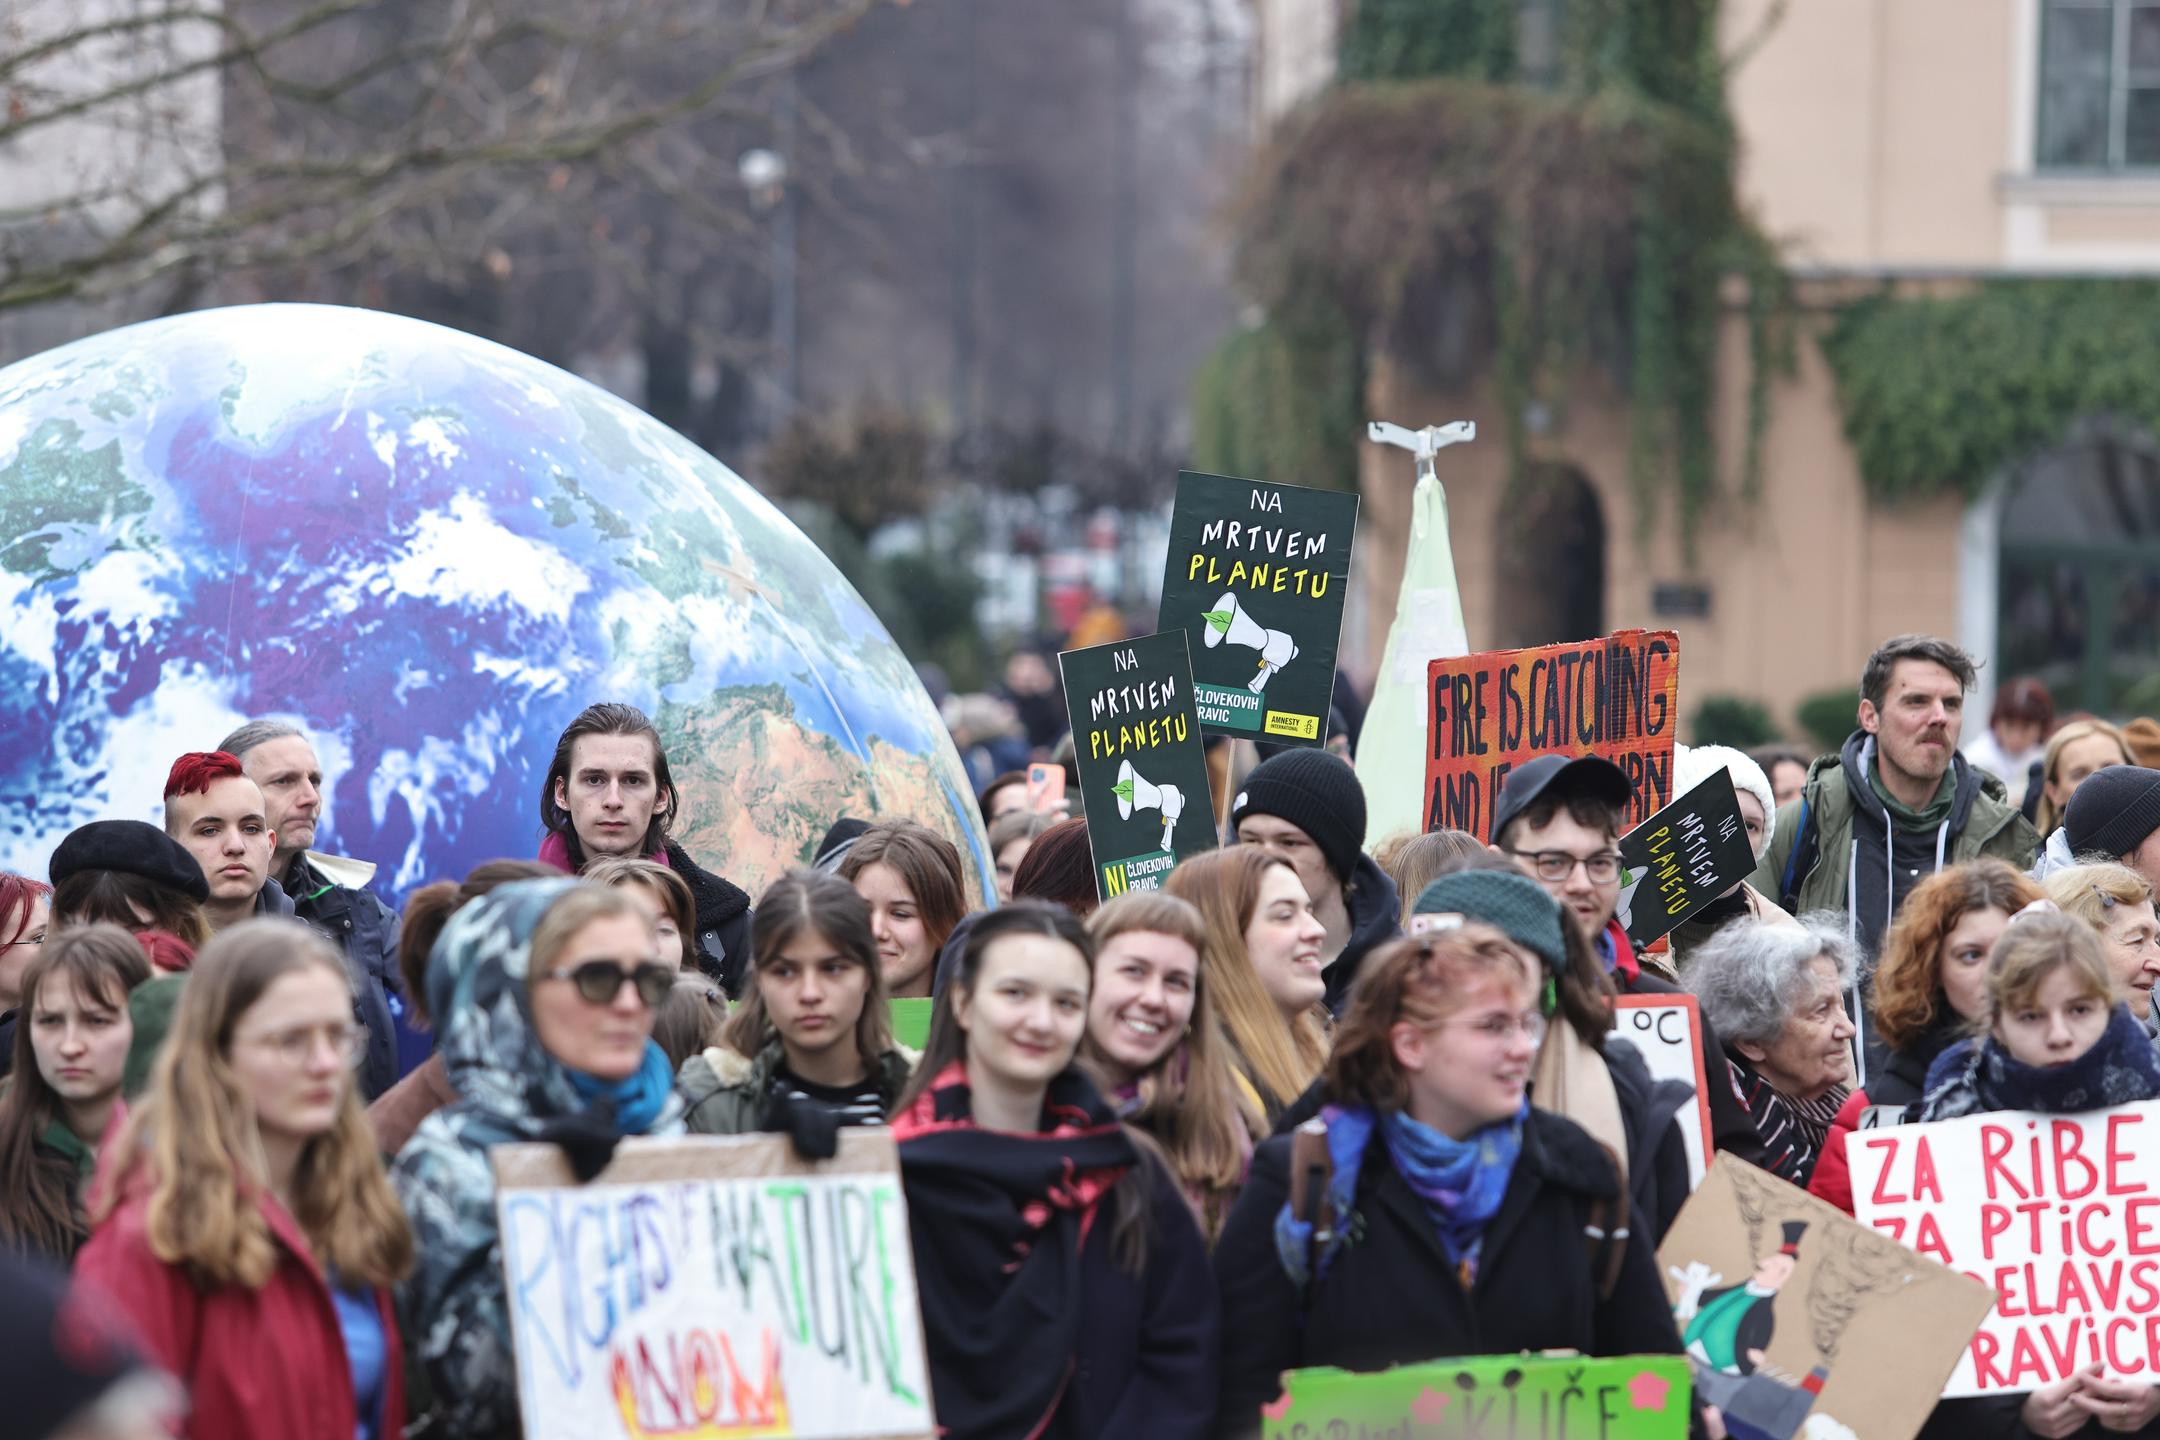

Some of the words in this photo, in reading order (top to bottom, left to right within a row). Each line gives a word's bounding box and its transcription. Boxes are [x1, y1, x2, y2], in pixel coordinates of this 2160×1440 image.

[1250, 489, 1283, 514] NA
[1201, 519, 1327, 560] MRTVEM
[1188, 553, 1330, 599] PLANETU
[1113, 648, 1139, 673] NA
[1090, 675, 1176, 722] MRTVEM
[1197, 706, 1230, 723] RAVIC
[1271, 715, 1301, 727] AMNESTY
[1434, 670, 1489, 759] FIRE
[1499, 662, 1524, 752] IS
[1528, 639, 1671, 750] CATCHING
[1090, 712, 1187, 760] PLANETU
[1427, 771, 1480, 838] AND
[1676, 812, 1720, 888] MRTVEM
[1717, 814, 1739, 844] NA
[1105, 863, 1128, 898] NI
[1127, 855, 1174, 878] ČLOVEKOVIH
[1130, 876, 1159, 893] PRAVIC
[1646, 825, 1691, 915] PLANETU
[1866, 1135, 1943, 1204] ZA
[709, 1183, 922, 1407] NATURE
[1963, 1260, 2160, 1318] ELAVS
[637, 1328, 777, 1427] NOW
